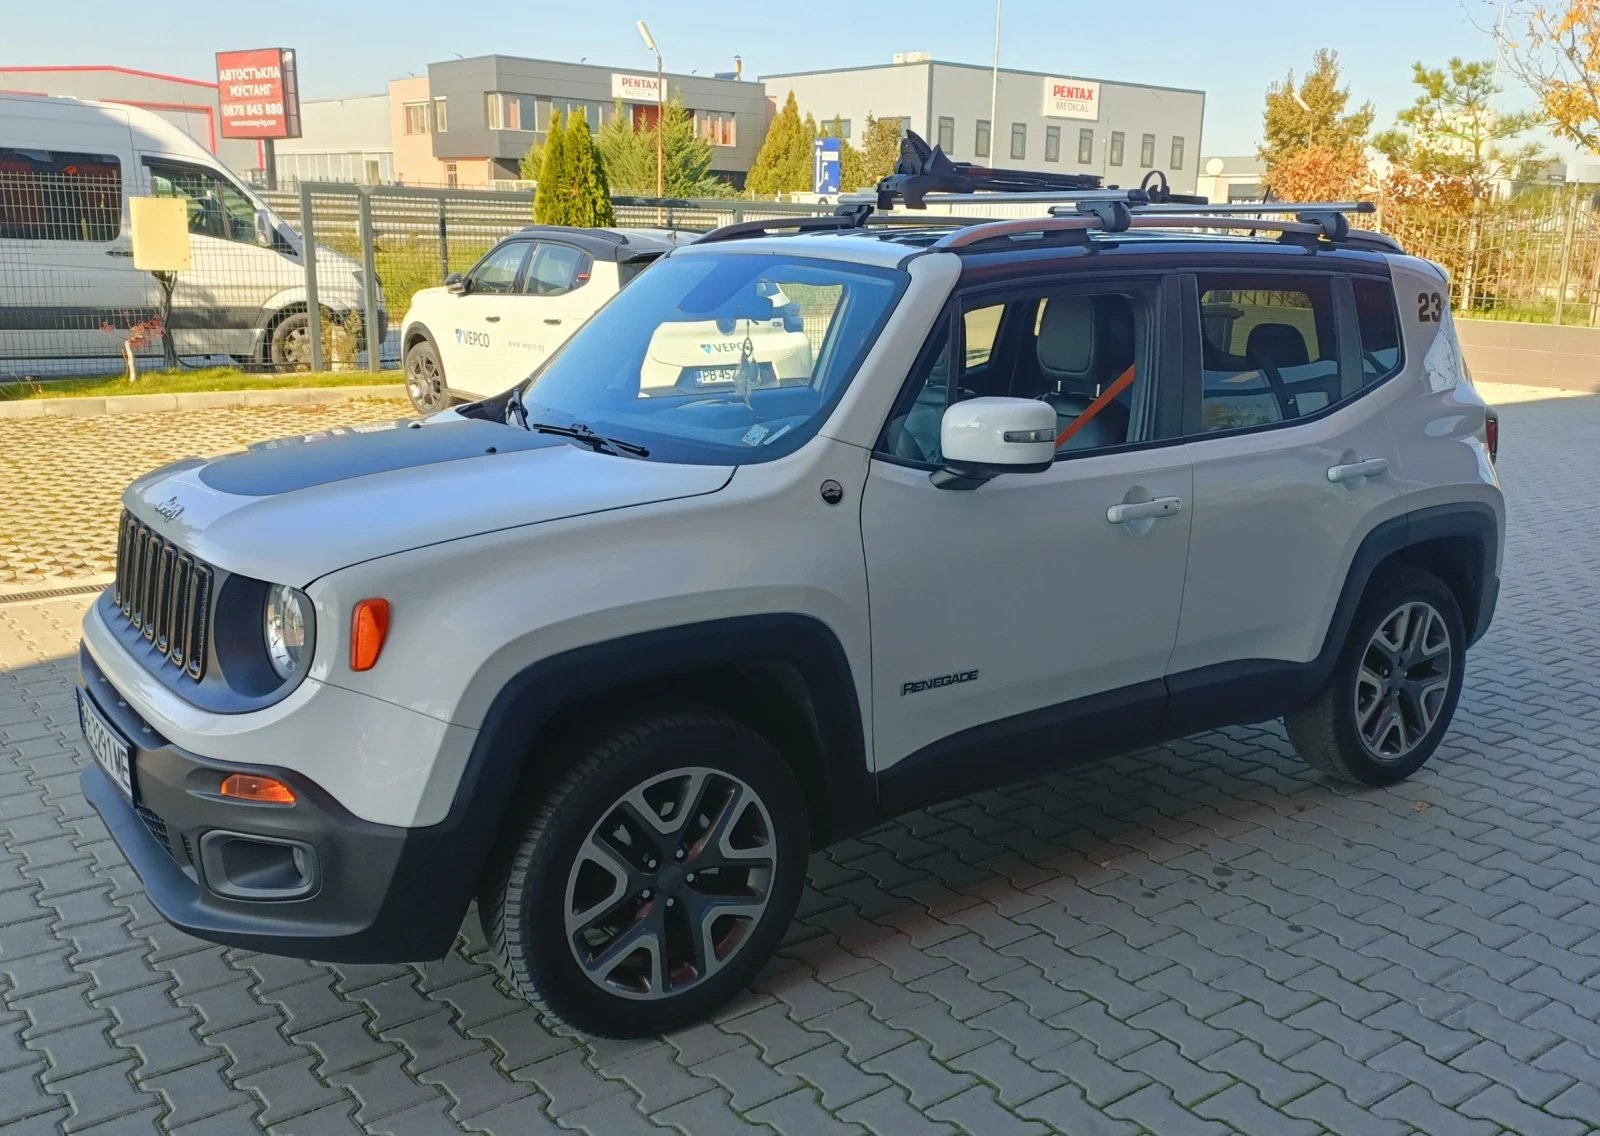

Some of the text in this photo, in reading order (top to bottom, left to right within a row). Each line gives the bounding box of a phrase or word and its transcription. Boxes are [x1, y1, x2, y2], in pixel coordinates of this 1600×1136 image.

[219, 66, 281, 81] АВТОСТЪКЛА
[229, 84, 272, 97] МУСТАНГ
[622, 77, 659, 90] PENTAX
[625, 90, 656, 99] MEDICAL
[1053, 85, 1094, 101] PENTAX
[223, 103, 283, 117] 0878 845 880
[1055, 101, 1089, 113] MEDICAL
[230, 119, 277, 127] www.mustang-bg.com
[1417, 292, 1442, 322] 23
[462, 330, 490, 348] VEPCO
[900, 668, 979, 697] RENEGADE
